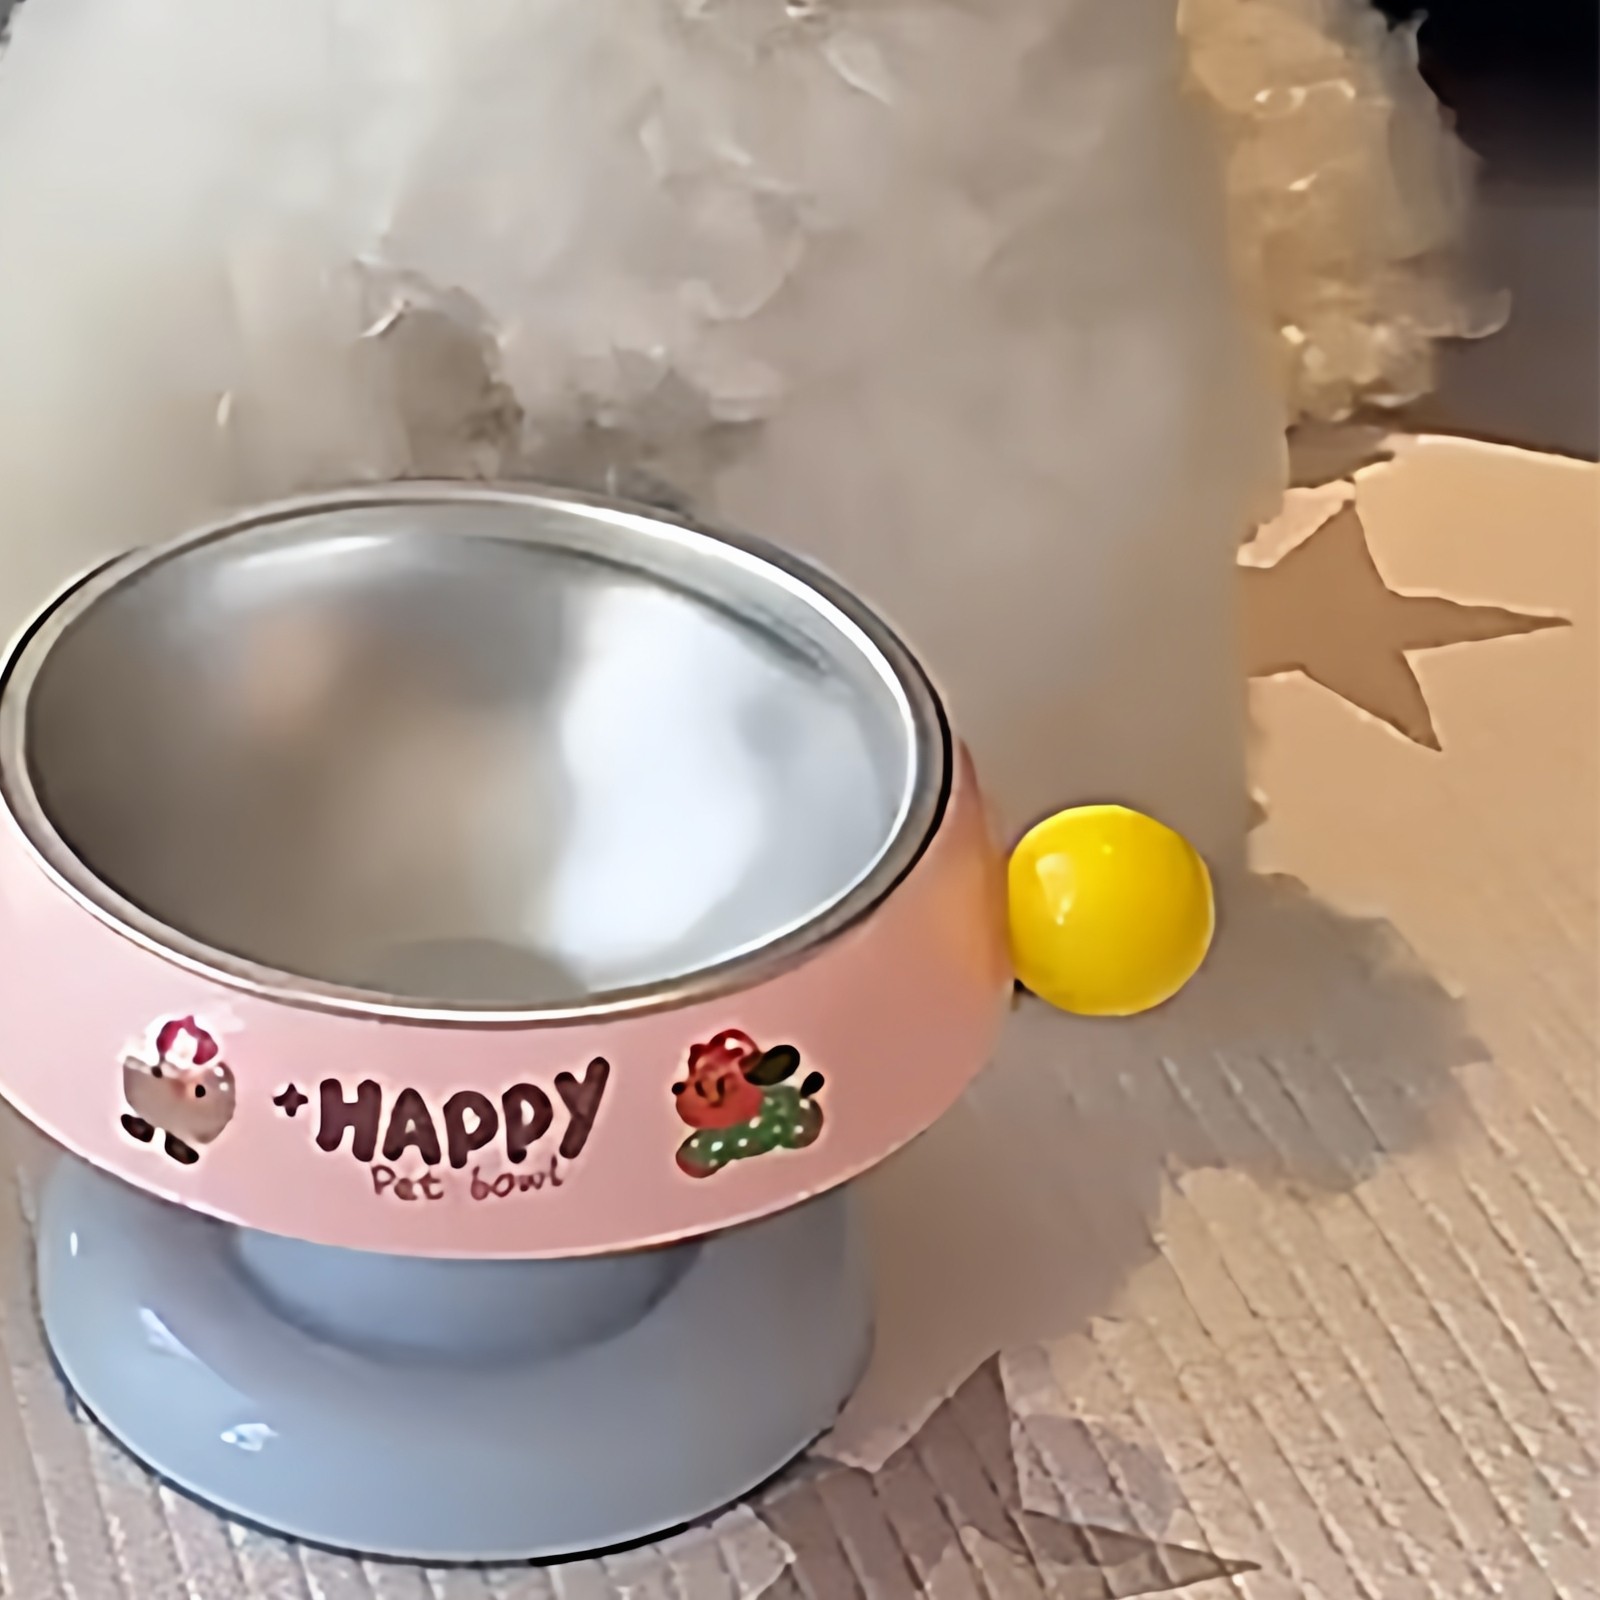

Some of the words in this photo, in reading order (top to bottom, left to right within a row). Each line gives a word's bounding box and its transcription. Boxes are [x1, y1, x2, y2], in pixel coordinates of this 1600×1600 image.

[315, 1056, 611, 1169] HAPPY
[370, 1163, 444, 1201] Pet
[470, 1154, 564, 1201] bowl
